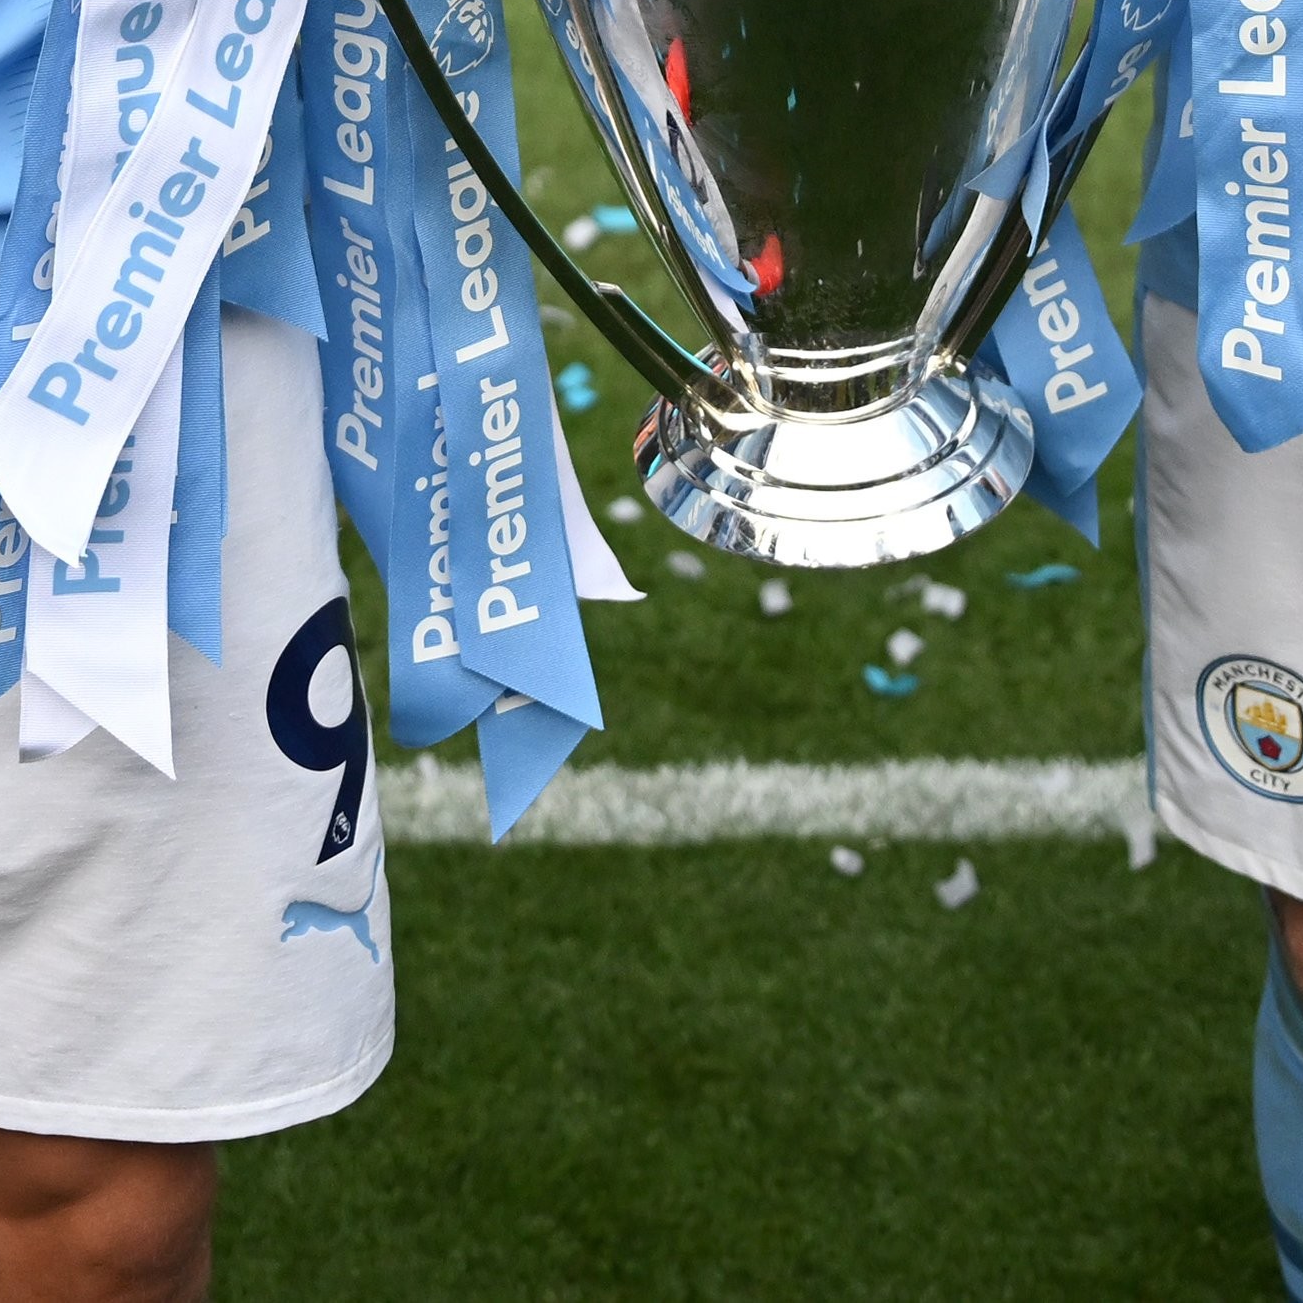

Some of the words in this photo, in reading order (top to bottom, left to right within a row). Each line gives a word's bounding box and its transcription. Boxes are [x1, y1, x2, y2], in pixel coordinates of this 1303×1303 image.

[27, 137, 221, 427] Premier
[336, 216, 384, 472] Premier
[1220, 117, 1293, 381] Premier
[469, 377, 540, 634] Premier
[266, 596, 368, 865] 9
[1249, 769, 1291, 792] CITY
